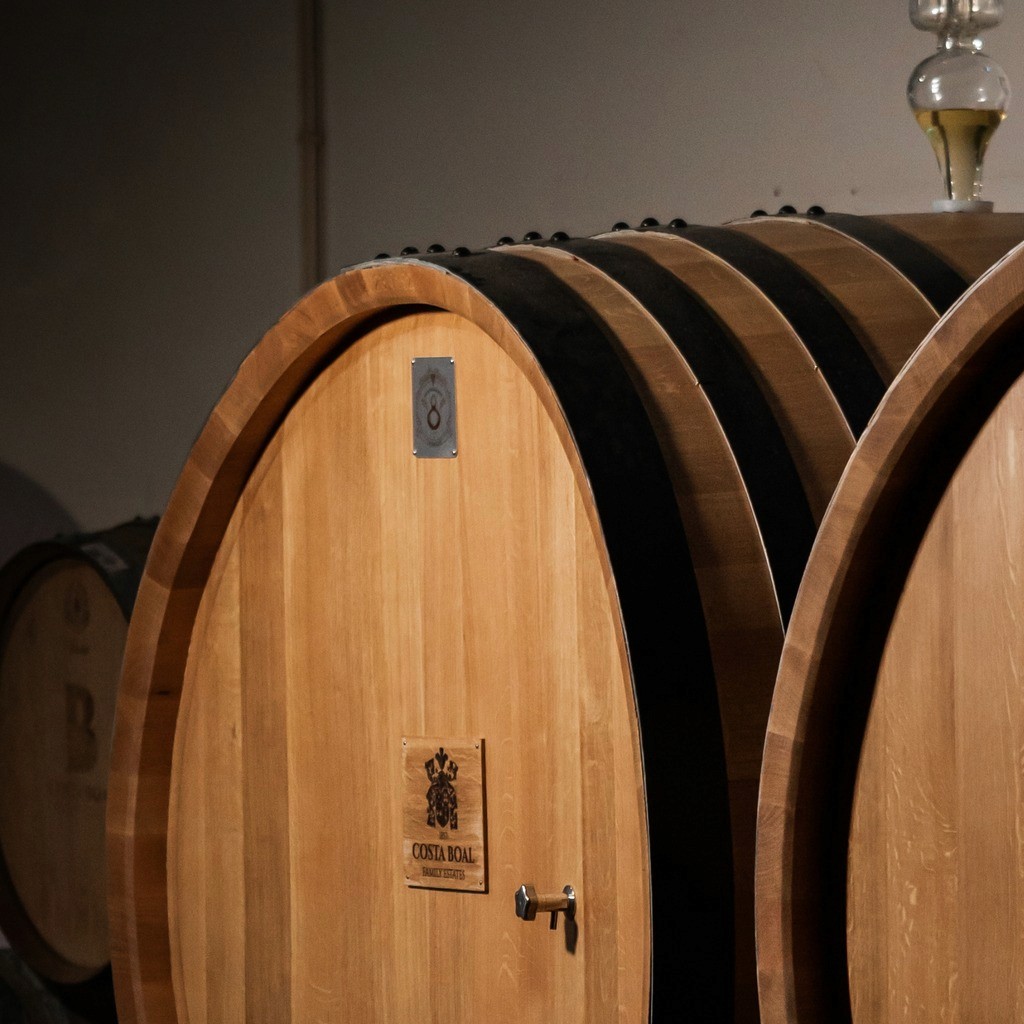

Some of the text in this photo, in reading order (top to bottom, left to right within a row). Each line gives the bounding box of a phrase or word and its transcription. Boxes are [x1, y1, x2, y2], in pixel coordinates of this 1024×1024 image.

[412, 842, 475, 864] COSTA BOAL
[422, 866, 465, 880] FAMILY ESTATES
